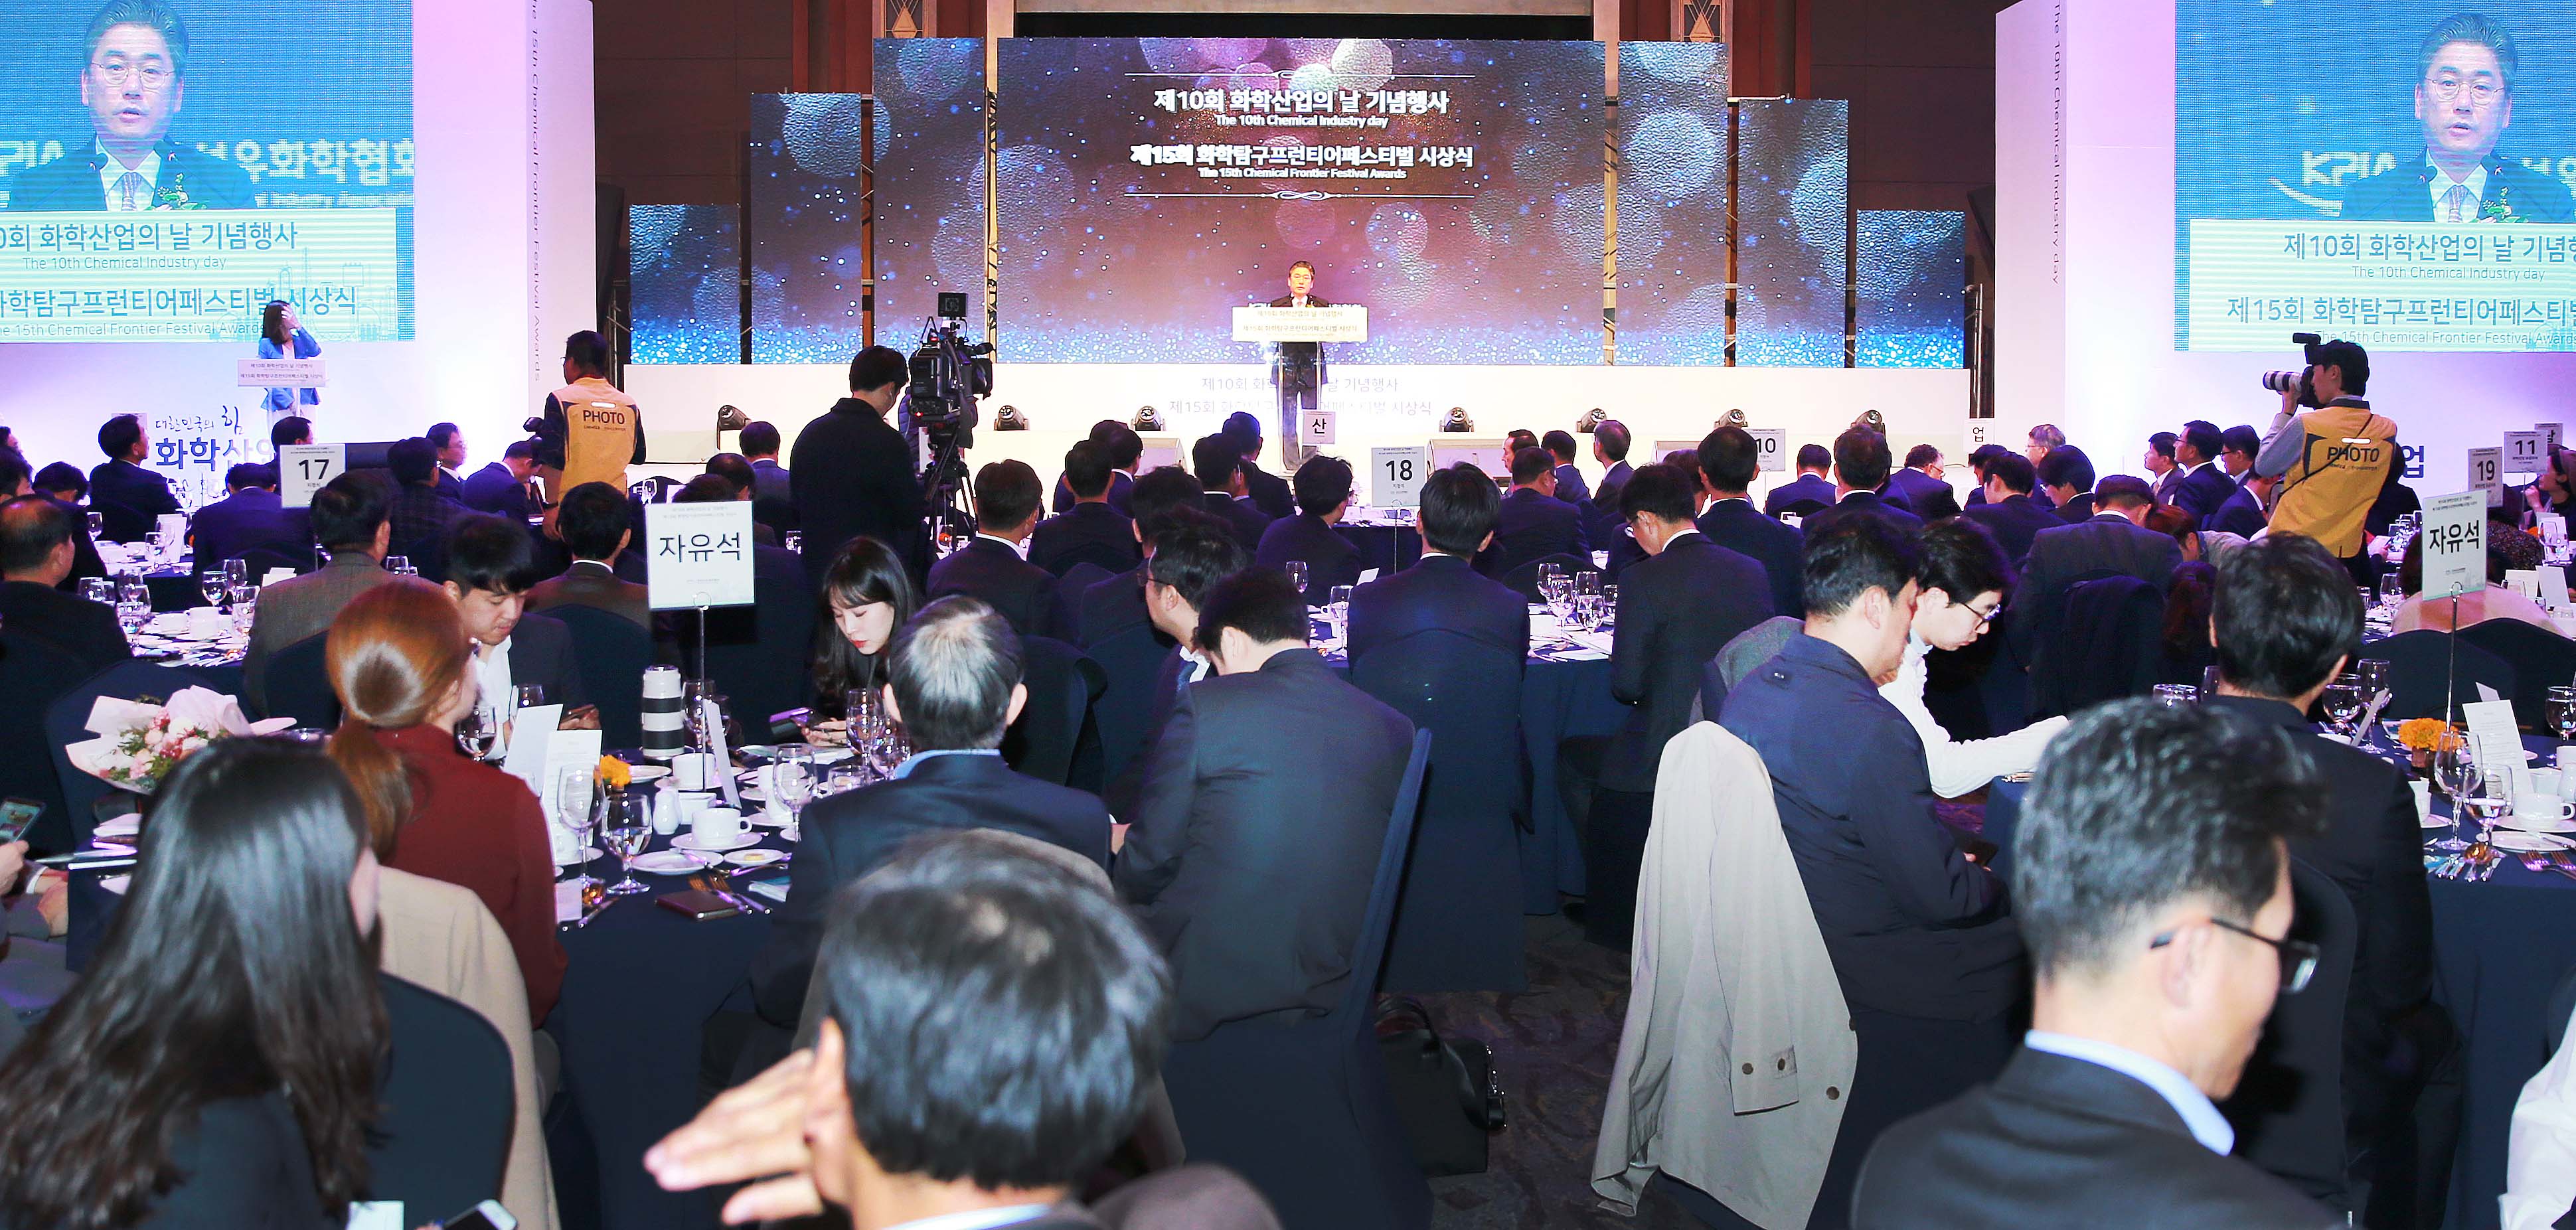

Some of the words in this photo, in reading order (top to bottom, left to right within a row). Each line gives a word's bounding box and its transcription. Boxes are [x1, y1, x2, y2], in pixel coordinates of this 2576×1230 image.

[1153, 88, 1226, 113] 제10회
[1228, 88, 1336, 114] 화학산업의
[1338, 90, 1362, 113] 날
[1366, 90, 1450, 114] 기념행사
[1216, 114, 1238, 126] The
[1239, 114, 1265, 126] 10th
[1266, 115, 1318, 126] Chemical
[1319, 115, 1367, 129] Industry
[1368, 115, 1390, 129] day
[1196, 144, 1415, 167] 화학탐구프런티어페스티벌
[1418, 145, 1475, 168] 시상식
[1197, 167, 1218, 178] The
[1219, 167, 1243, 178] 15th
[1244, 167, 1289, 179] Chemical
[1289, 168, 1330, 179] Frontier
[1330, 168, 1369, 179] Festival
[1369, 169, 1408, 179] Awards
[40, 222, 160, 252] 화학산업의
[169, 222, 193, 251] 날
[201, 221, 298, 251] 기념행사
[2283, 233, 2360, 260] 제10회
[2369, 233, 2484, 262] 화학산업의
[2492, 234, 2515, 262] 날
[23, 256, 46, 269] The
[51, 256, 80, 269] 10th
[84, 256, 143, 269] Chemical
[147, 256, 200, 271] Industry
[203, 255, 227, 271] day
[2351, 266, 2375, 278] The
[2379, 266, 2407, 279] 10th
[2410, 266, 2466, 279] Chemical
[2469, 267, 2520, 282] Industry
[2523, 268, 2545, 282] day
[289, 286, 356, 315] 시상식
[2227, 297, 2304, 325] 제15회
[16, 323, 44, 336] 15th
[48, 323, 106, 336] Chemical
[110, 323, 161, 335] Frontier
[166, 322, 216, 335] Festival
[2342, 331, 2370, 344] 15th
[2372, 331, 2429, 344] Chemical
[2432, 331, 2482, 344] Frontier
[2485, 331, 2532, 345] Festival
[1202, 376, 1247, 392] 제10회
[1344, 377, 1399, 393] 기념행사
[1169, 400, 1215, 415] 제15회
[1392, 400, 1433, 416] 시상식
[155, 415, 214, 433] 대한민국의
[583, 410, 625, 425] PHOTO
[1312, 418, 1327, 435] 산
[1972, 427, 1984, 442] 업
[1755, 438, 1777, 453] 10
[2515, 439, 2536, 455] 11
[2327, 447, 2380, 463] PHOTO
[299, 459, 330, 480] 17
[1386, 459, 1413, 481] 18
[2477, 459, 2495, 482] 19
[2429, 519, 2480, 555] 자유석
[659, 532, 740, 563] 자유석
